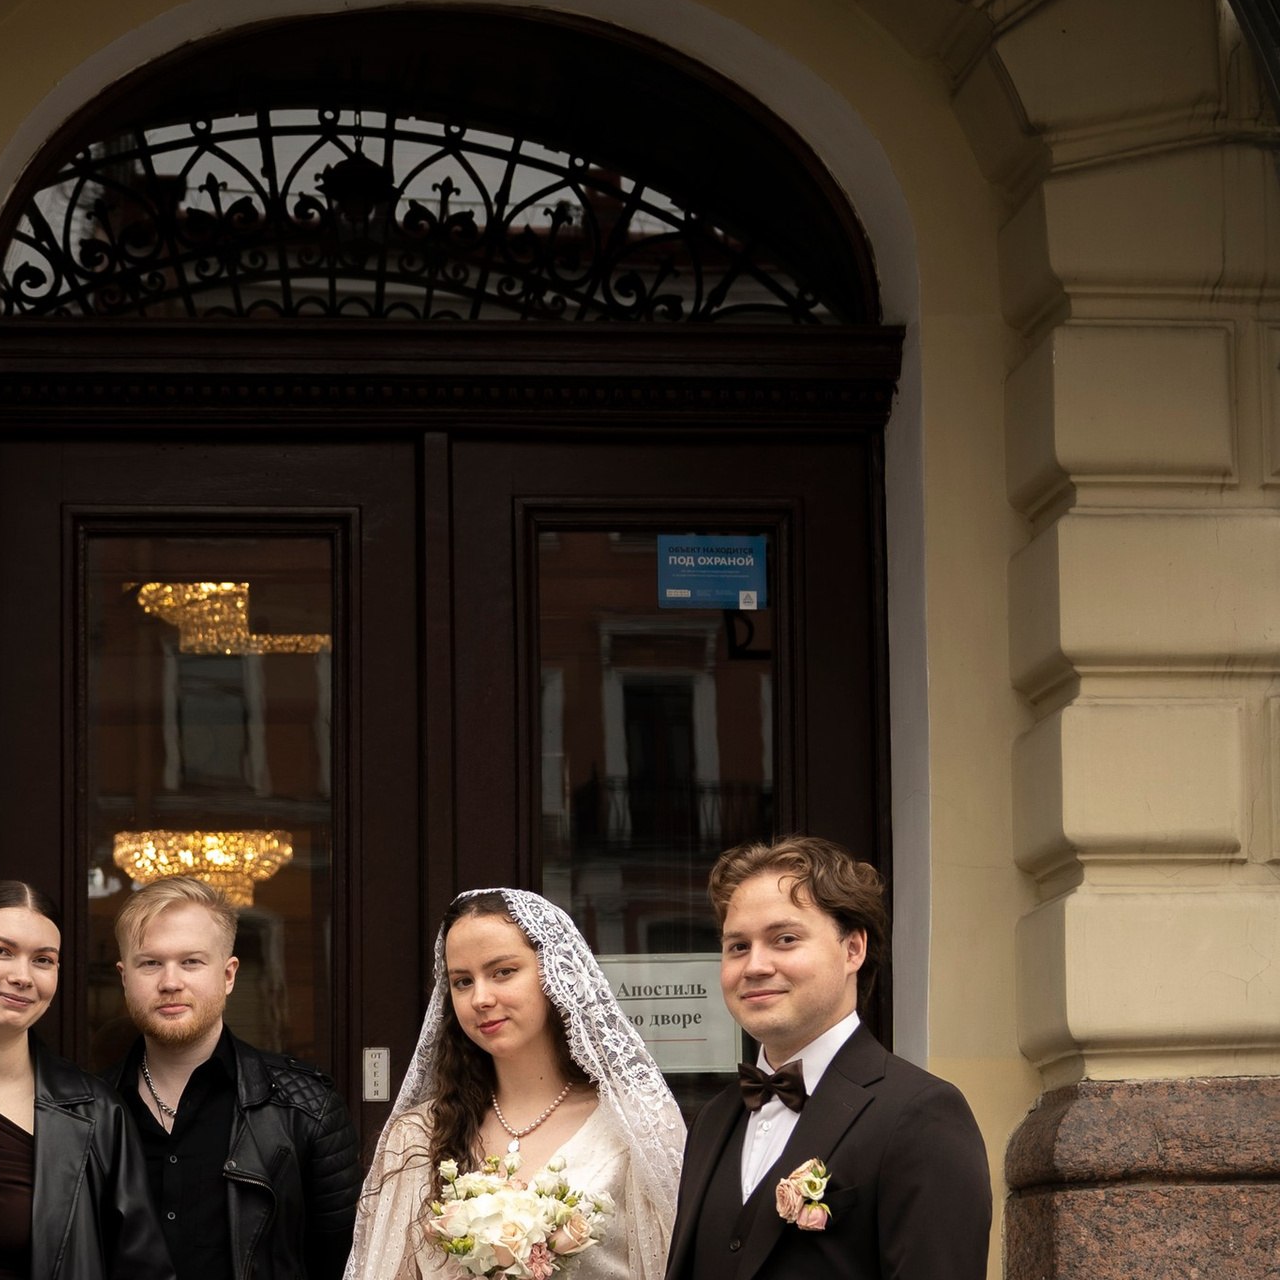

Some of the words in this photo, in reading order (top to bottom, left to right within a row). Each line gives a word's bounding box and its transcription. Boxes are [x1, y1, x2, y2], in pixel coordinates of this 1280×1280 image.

[703, 547, 754, 555] НАХОДИТСЯ
[668, 556, 695, 567] ПОД
[697, 555, 755, 566] ОХРАНОЙ
[616, 982, 707, 997] Апостиль
[649, 1012, 702, 1029] дворе
